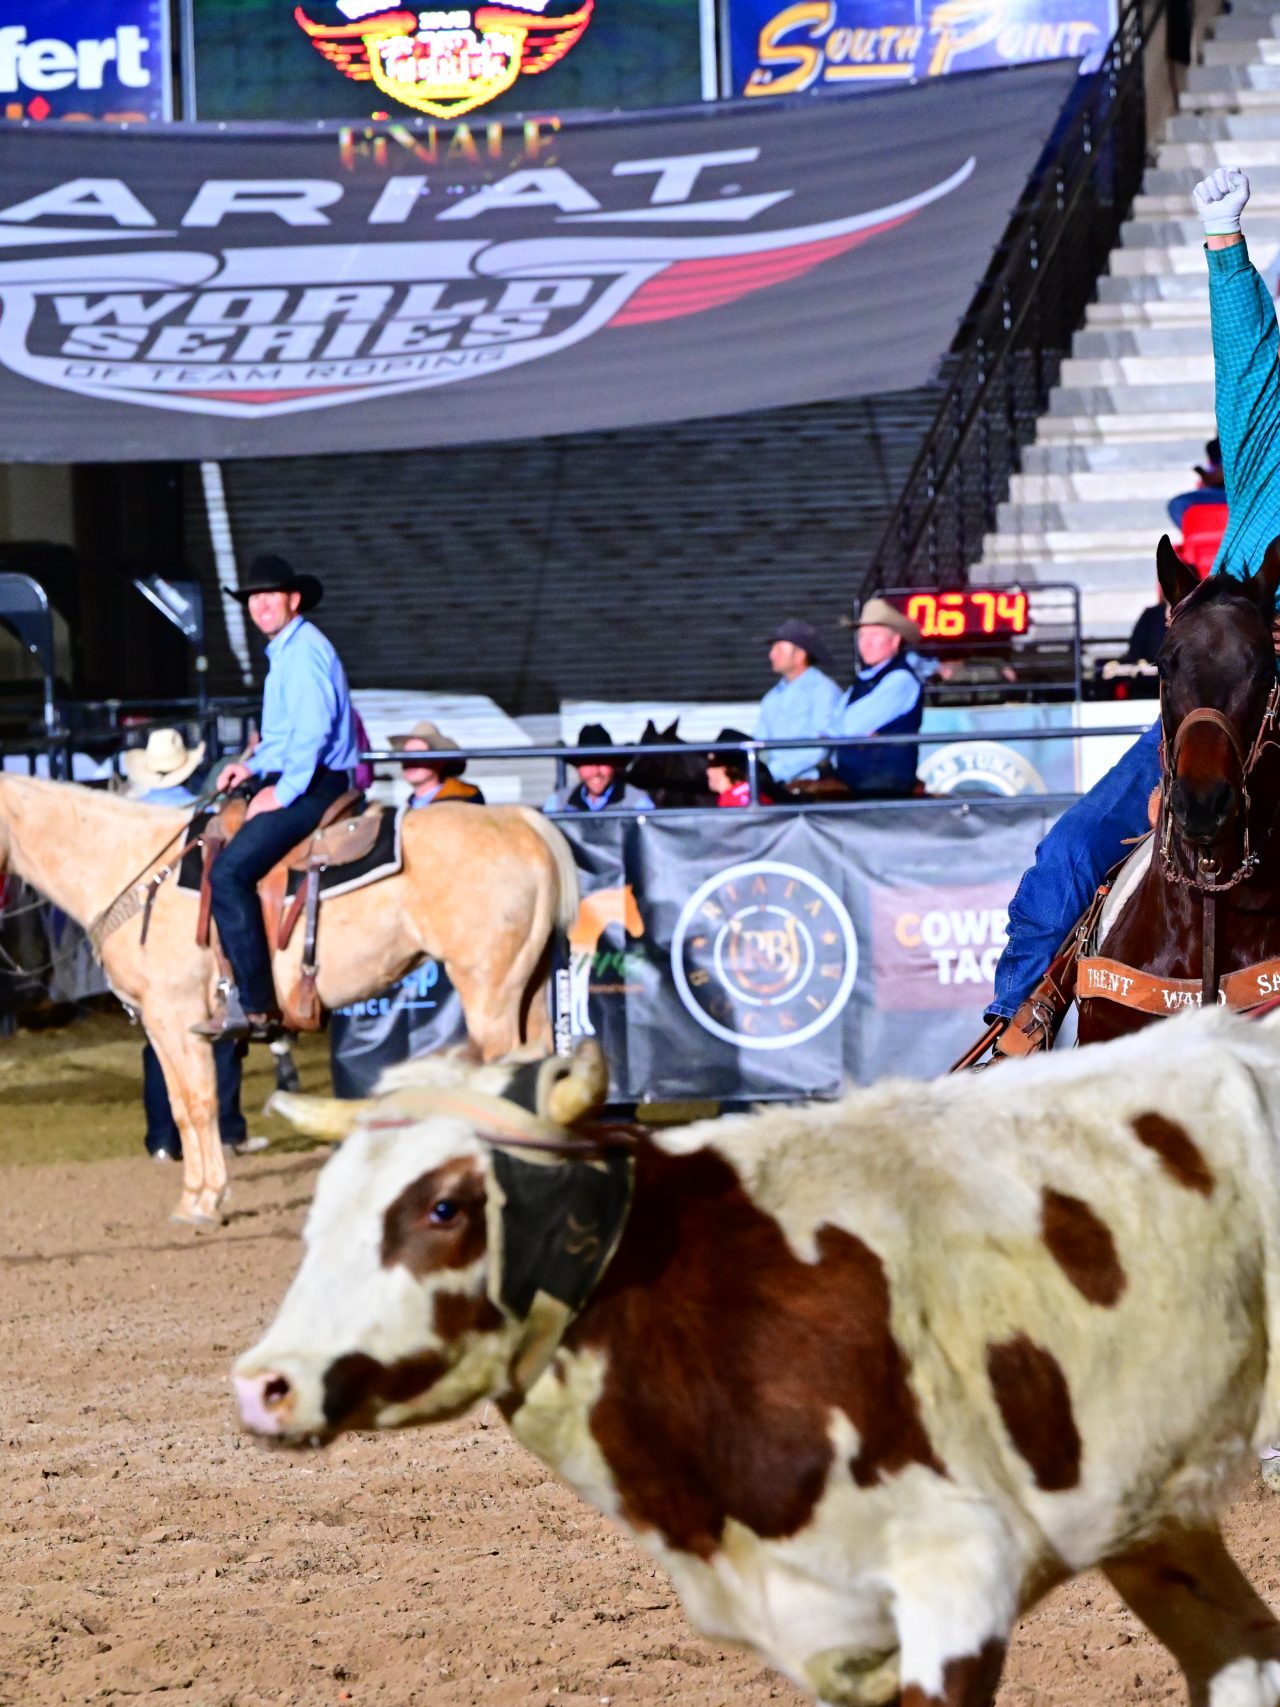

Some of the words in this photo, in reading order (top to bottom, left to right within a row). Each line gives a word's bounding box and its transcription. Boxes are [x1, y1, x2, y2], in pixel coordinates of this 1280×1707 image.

[0, 147, 762, 227] ARIAT
[52, 277, 594, 326] WORLD
[62, 310, 548, 363] SERIES
[62, 364, 126, 381] OF
[148, 364, 284, 384] TEAM
[305, 347, 508, 379] ROPING
[1087, 968, 1134, 996] TRENT
